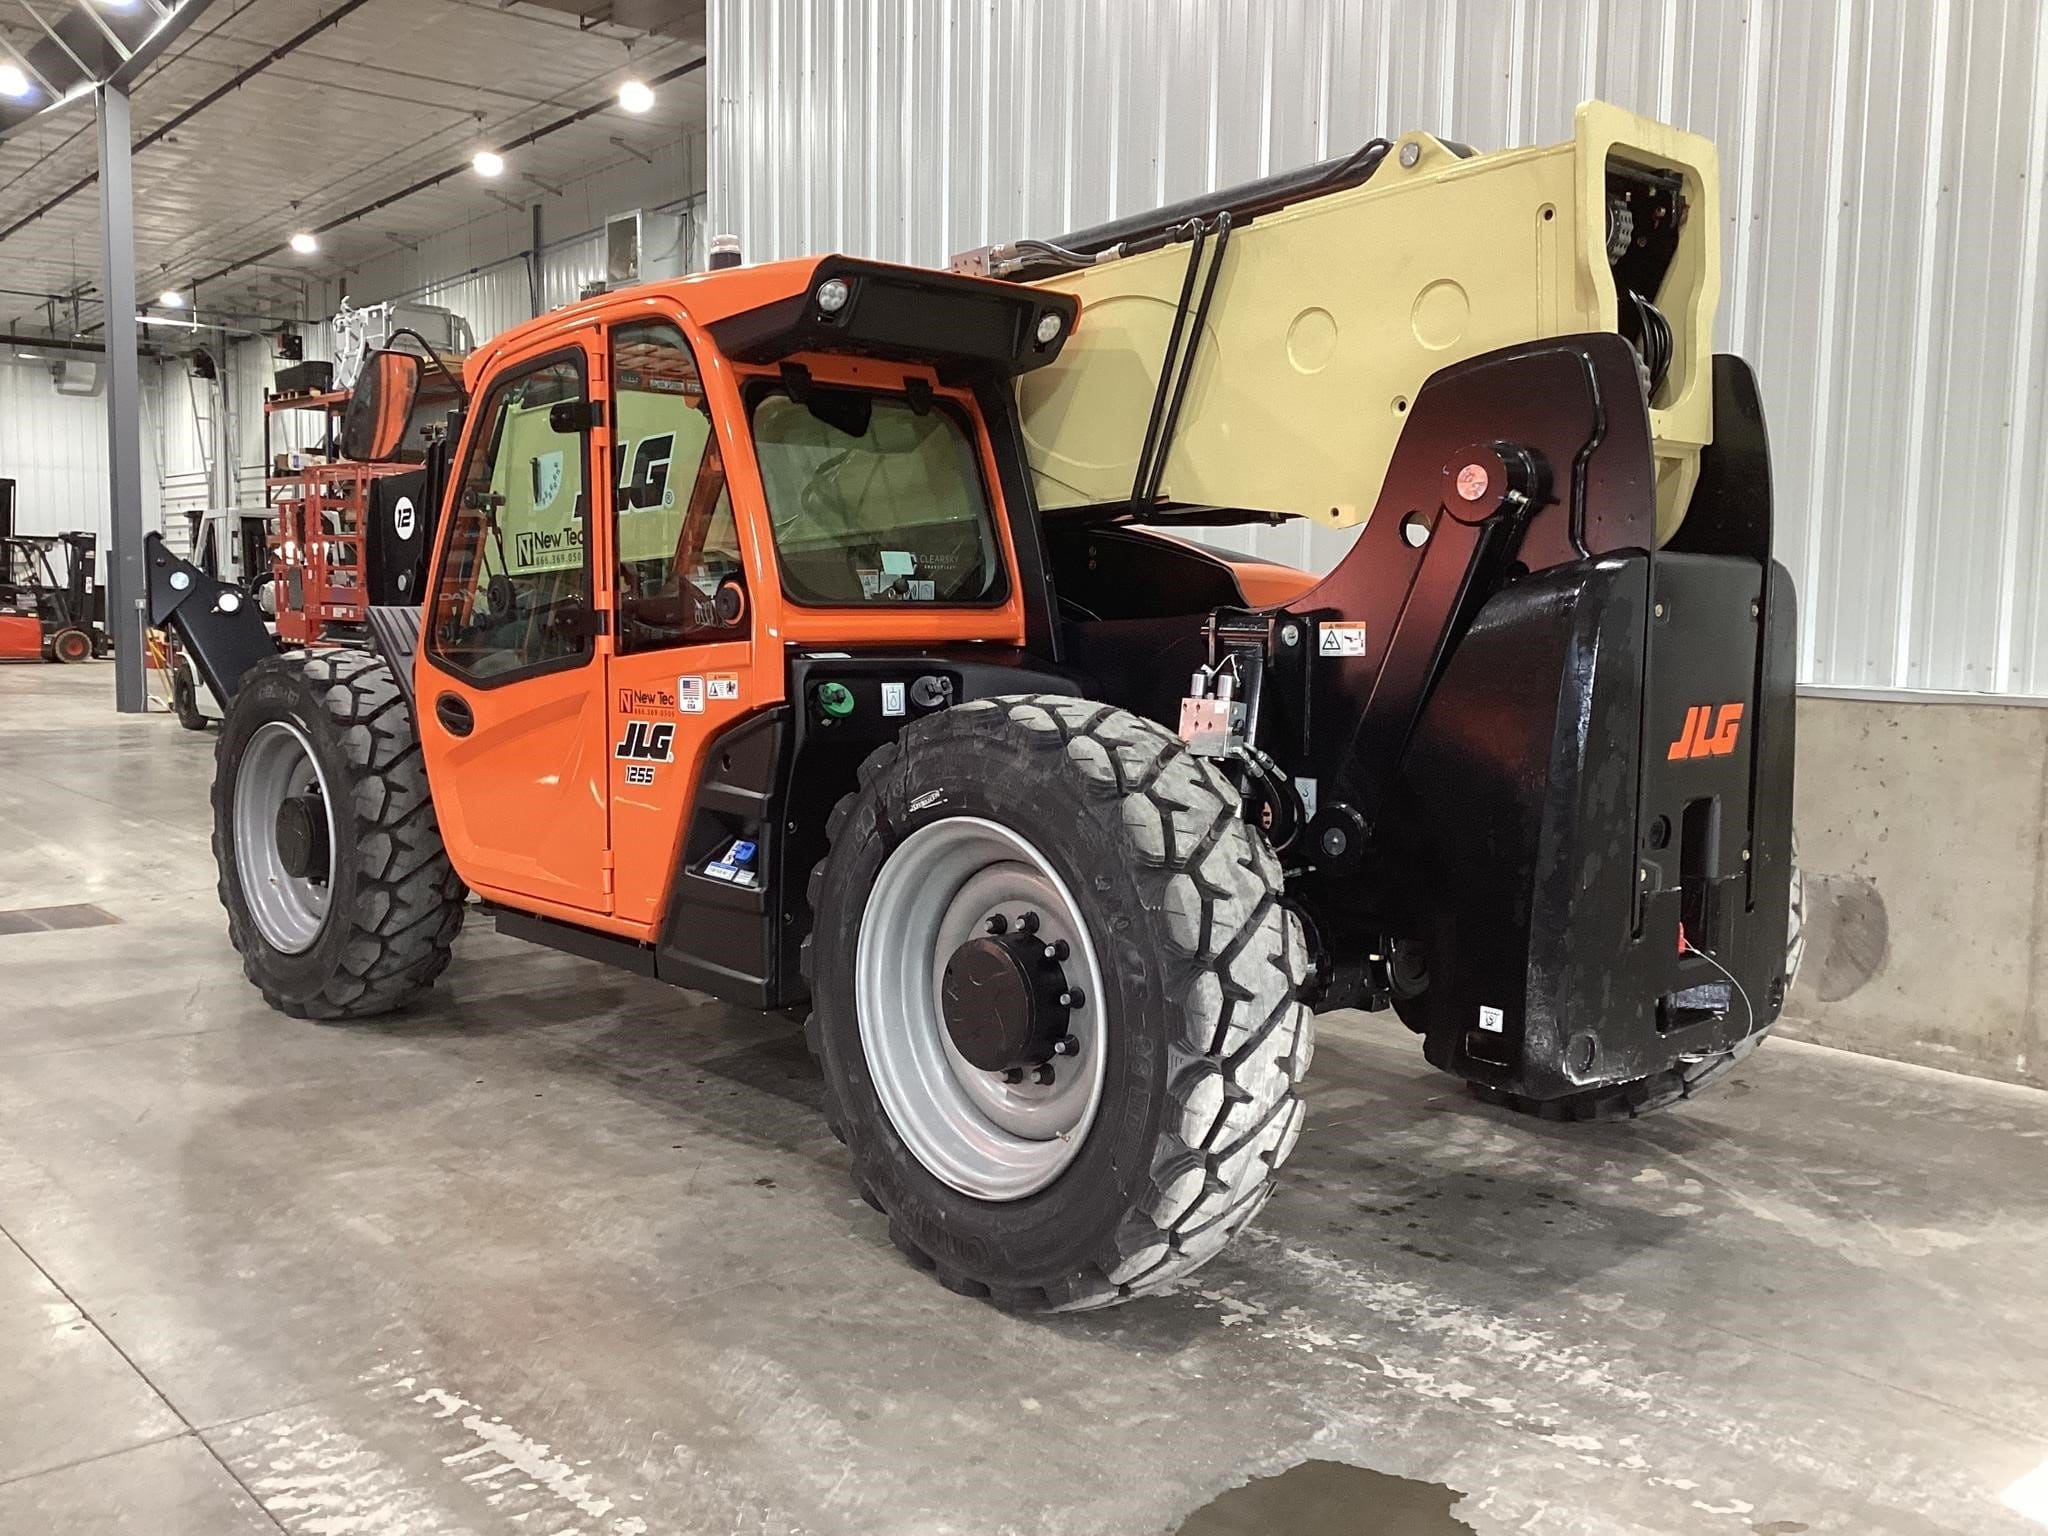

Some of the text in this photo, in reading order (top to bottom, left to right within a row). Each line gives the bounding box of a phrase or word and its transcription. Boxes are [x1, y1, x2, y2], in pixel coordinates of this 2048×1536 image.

[397, 507, 412, 529] 12
[534, 531, 562, 550] New
[634, 689, 656, 704] New
[657, 691, 675, 706] Tec
[615, 722, 675, 761] JLG
[1668, 703, 1745, 761] JLG
[626, 766, 654, 784] 1255
